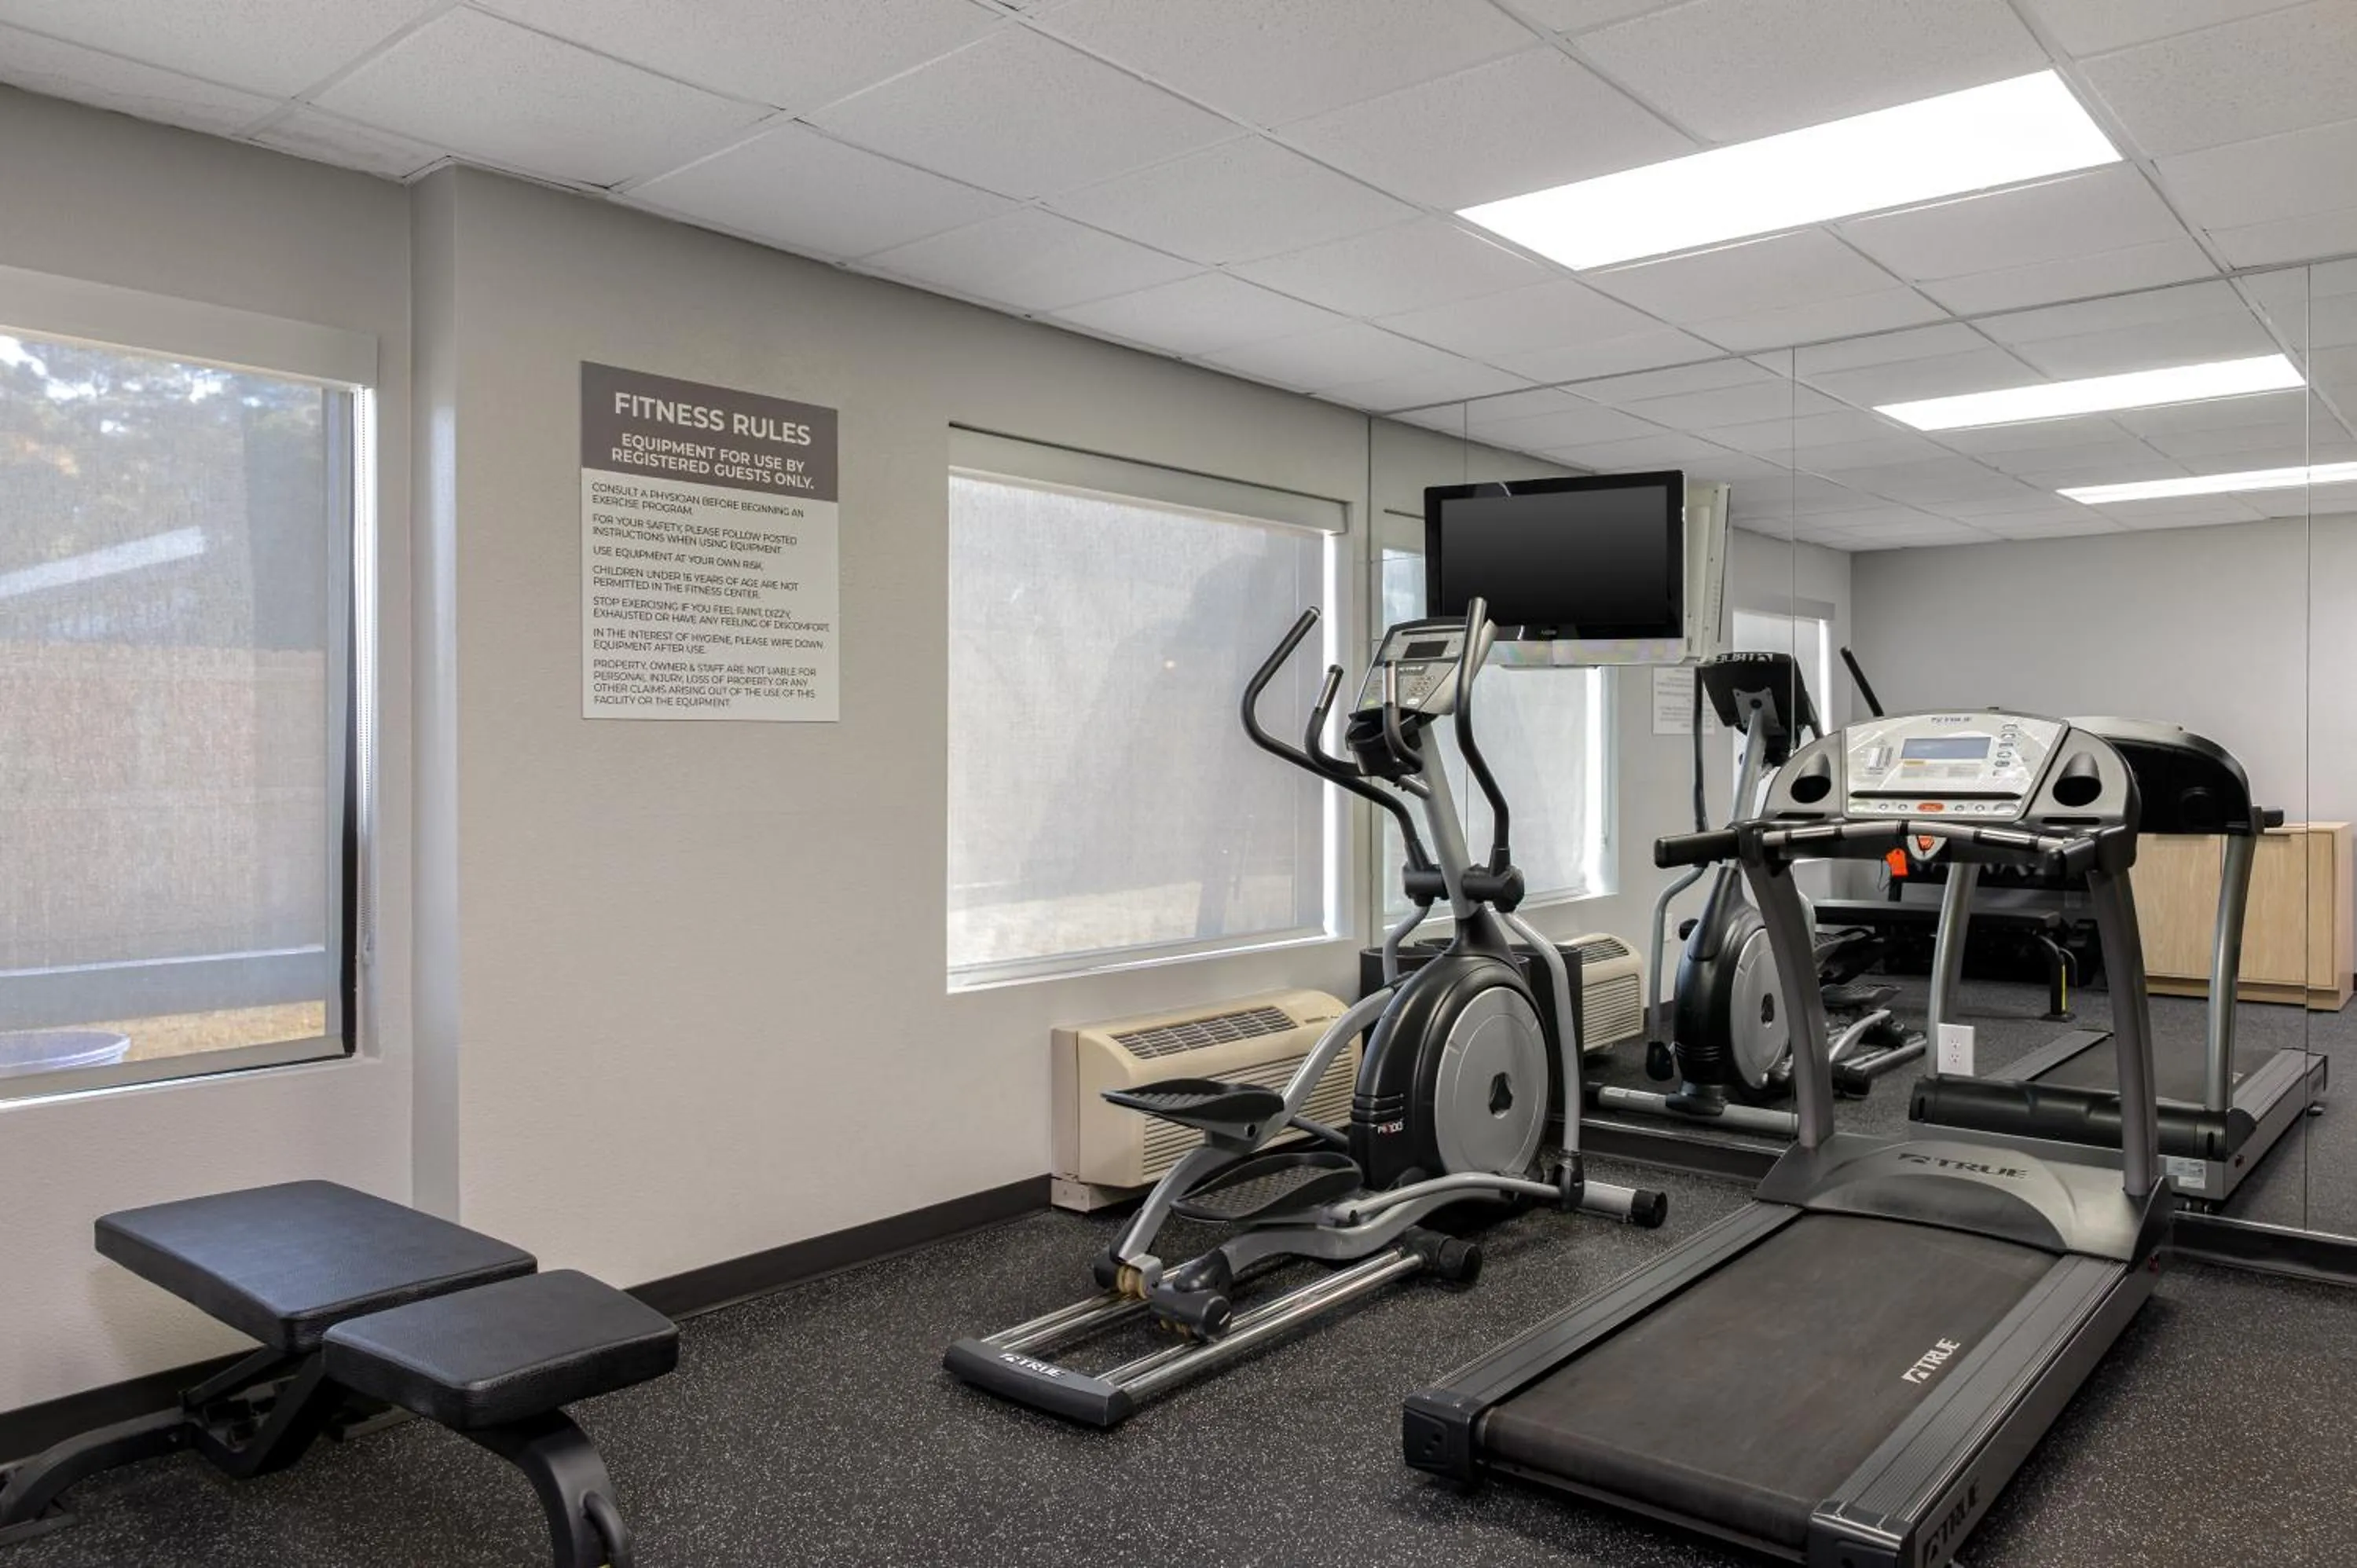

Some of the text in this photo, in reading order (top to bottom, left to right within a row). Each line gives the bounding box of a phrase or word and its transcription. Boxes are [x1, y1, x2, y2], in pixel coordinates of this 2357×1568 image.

[614, 390, 811, 446] FITNESS RULES
[621, 432, 805, 474] EQUIPMENT FOR USE BY
[611, 447, 814, 490] REGISTERED GUESTS ONLY.
[592, 481, 804, 518] CONSULT A PHYSICIAN BEFORE BEGINNING AN
[592, 493, 639, 509] EXERCISE
[592, 512, 614, 525] FOR
[615, 515, 643, 528] YOUR
[684, 523, 720, 537] PLEASE
[722, 527, 761, 541] FOLLOW
[763, 533, 797, 545] POSTED
[592, 525, 665, 543] INSTRUCTIONS
[667, 533, 696, 546] WHEN
[699, 537, 727, 549] USING
[592, 544, 612, 556] USE
[615, 547, 673, 562] EQUIPMENT
[674, 552, 685, 563] AT
[687, 554, 713, 566] YOUR
[716, 557, 740, 569] OWN
[592, 563, 643, 578] CHILDREN
[646, 569, 680, 581] UNDER
[693, 573, 724, 585] YEARS
[725, 576, 739, 586] OF
[740, 577, 758, 588] AGE
[760, 579, 778, 590] ARE
[780, 581, 798, 592] NOT
[592, 576, 648, 590] PERMITTED
[651, 581, 662, 592] IN
[664, 582, 682, 593] THE
[684, 584, 721, 596] FITNESS
[592, 595, 620, 607] STOP
[621, 597, 679, 611] EXERCISING
[690, 603, 710, 614] YOU
[713, 604, 733, 615] FEEL
[592, 607, 652, 621] EXHAUSTED
[654, 611, 670, 622] OR
[672, 613, 696, 624] HAVE
[698, 614, 718, 625] ANY
[720, 616, 757, 628] FEELING
[758, 619, 772, 628] OF
[592, 626, 603, 637] IN
[607, 628, 625, 639] THE
[628, 628, 673, 641] INTEREST
[674, 632, 688, 642] OF
[735, 635, 768, 647] PLEASE
[771, 637, 793, 648] WIPE
[794, 639, 823, 650] DOWN
[593, 639, 651, 652] EQUIPMENT
[653, 642, 684, 654] AFTER
[649, 660, 687, 672] OWNER
[697, 662, 725, 673] STAFF
[726, 664, 745, 674] ARE
[746, 665, 765, 675] NOT
[768, 665, 796, 676] LIABLE
[797, 667, 816, 676] FOR
[592, 682, 628, 693] OTHER
[668, 684, 706, 695] ARISING
[707, 686, 727, 696] OUT
[728, 687, 742, 696] OF
[744, 687, 761, 697] THE
[763, 687, 779, 698] USE
[782, 688, 795, 698] OF
[797, 689, 815, 698] THIS
[686, 674, 709, 683] LOSS
[711, 675, 726, 684] OF
[727, 676, 773, 686] PROPERTY
[775, 677, 788, 687] OR
[790, 678, 808, 687] ANY
[593, 694, 636, 705] FACILITY
[636, 695, 652, 705] OR
[655, 696, 673, 706] THE
[1913, 1338, 1961, 1370] TRUE
